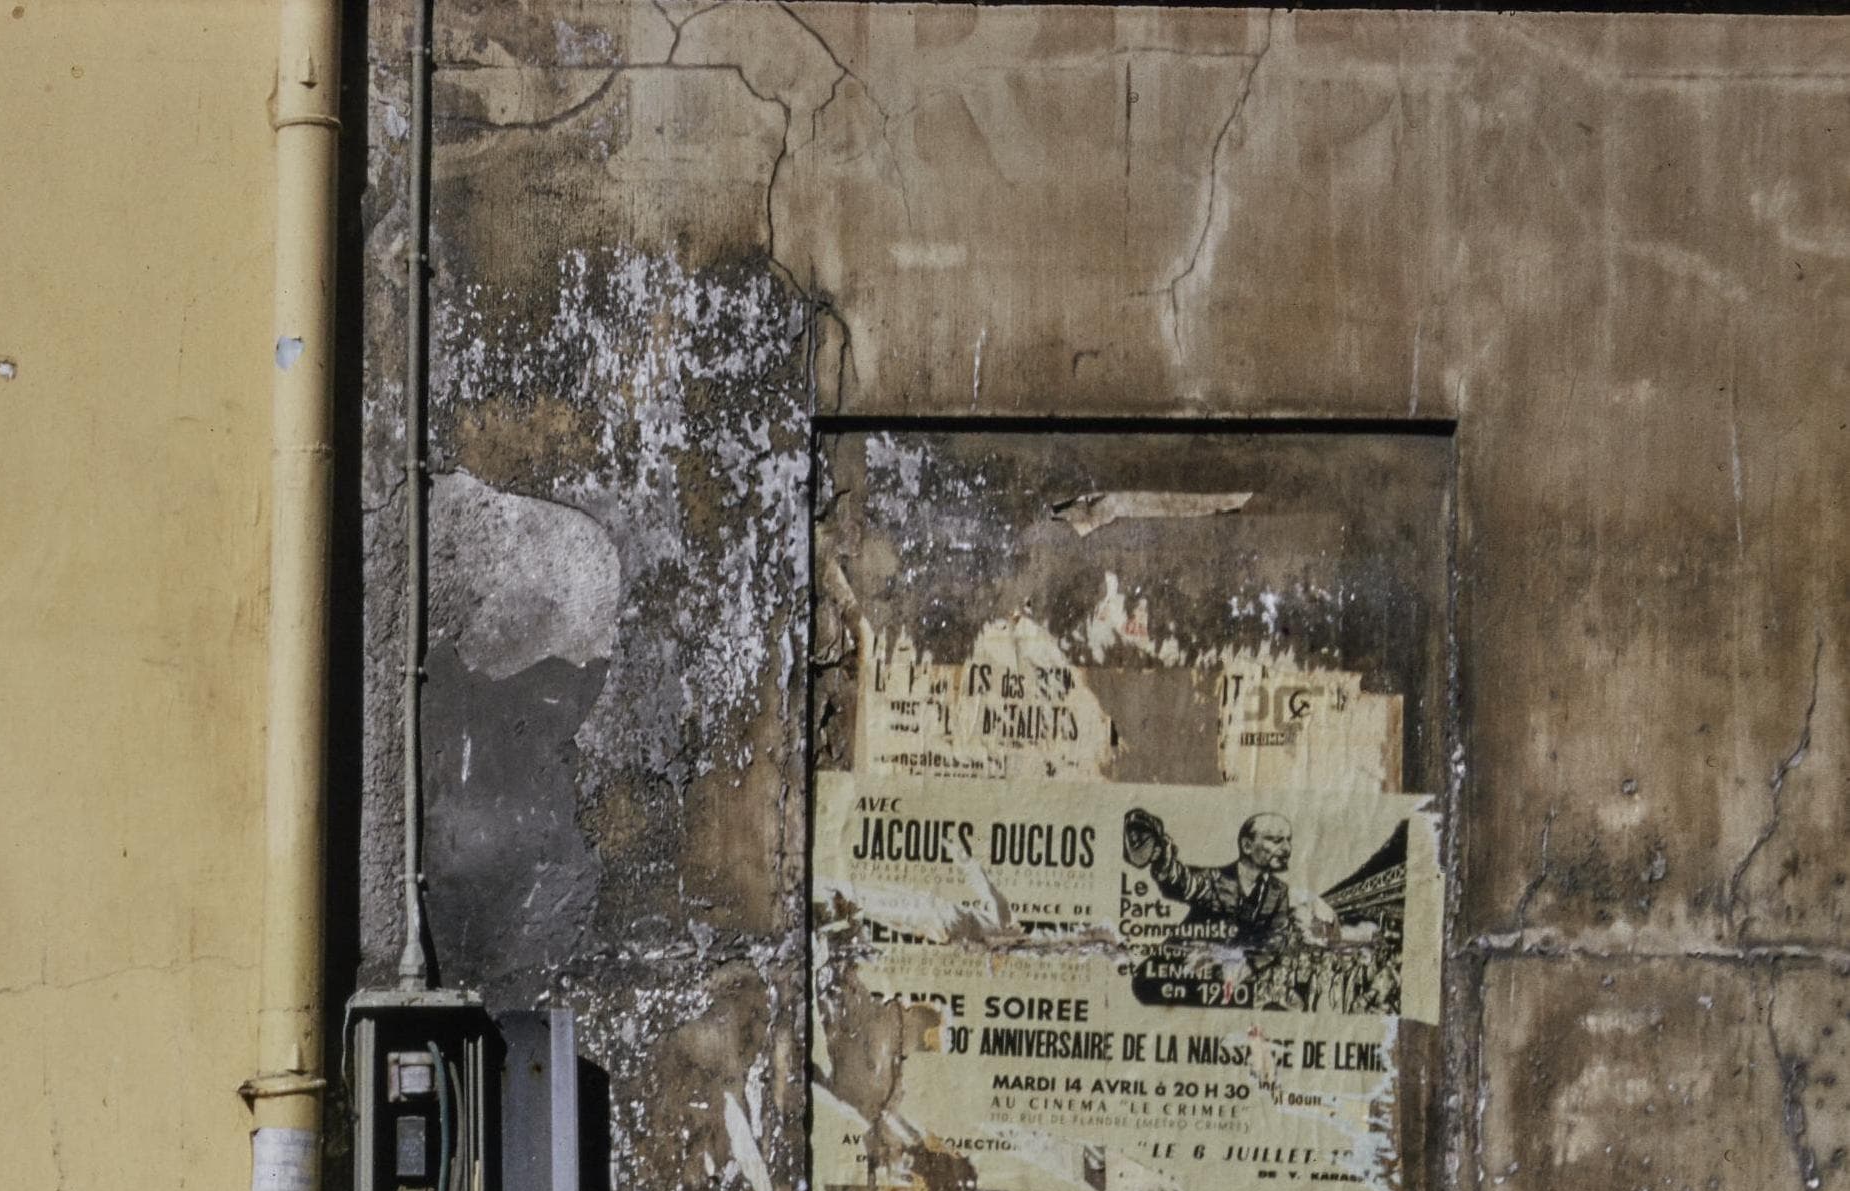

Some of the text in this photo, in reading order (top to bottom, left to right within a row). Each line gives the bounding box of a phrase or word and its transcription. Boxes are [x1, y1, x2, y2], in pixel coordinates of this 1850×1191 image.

[854, 796, 902, 813] AVEC
[853, 816, 1096, 868] JACQUES DUCLOS
[1121, 872, 1149, 896] Le
[1073, 904, 1093, 916] DE
[1120, 897, 1171, 918] Parti
[1119, 919, 1239, 938] Communiste
[1117, 962, 1138, 976] et
[1161, 982, 1186, 998] en
[984, 995, 1089, 1022] SOIREE
[980, 1026, 1114, 1061] ANNIVERSAIRE
[1122, 1033, 1147, 1062] DE
[1155, 1034, 1178, 1064] LA
[1302, 1040, 1326, 1070] DE
[992, 1075, 1056, 1092] MARDI
[1064, 1077, 1082, 1093] 14
[1091, 1079, 1147, 1096] AVRIL
[1173, 1082, 1199, 1098] 20
[1205, 1083, 1218, 1098] H
[1224, 1084, 1250, 1100] 30
[990, 1095, 1016, 1109] AU
[1029, 1097, 1107, 1113] CINEMA
[1020, 1114, 1043, 1124] RUE
[1050, 1115, 1066, 1125] DE
[1072, 1116, 1127, 1127] FLANDRE
[1193, 1144, 1206, 1160] 6
[1258, 1170, 1277, 1180] DE
